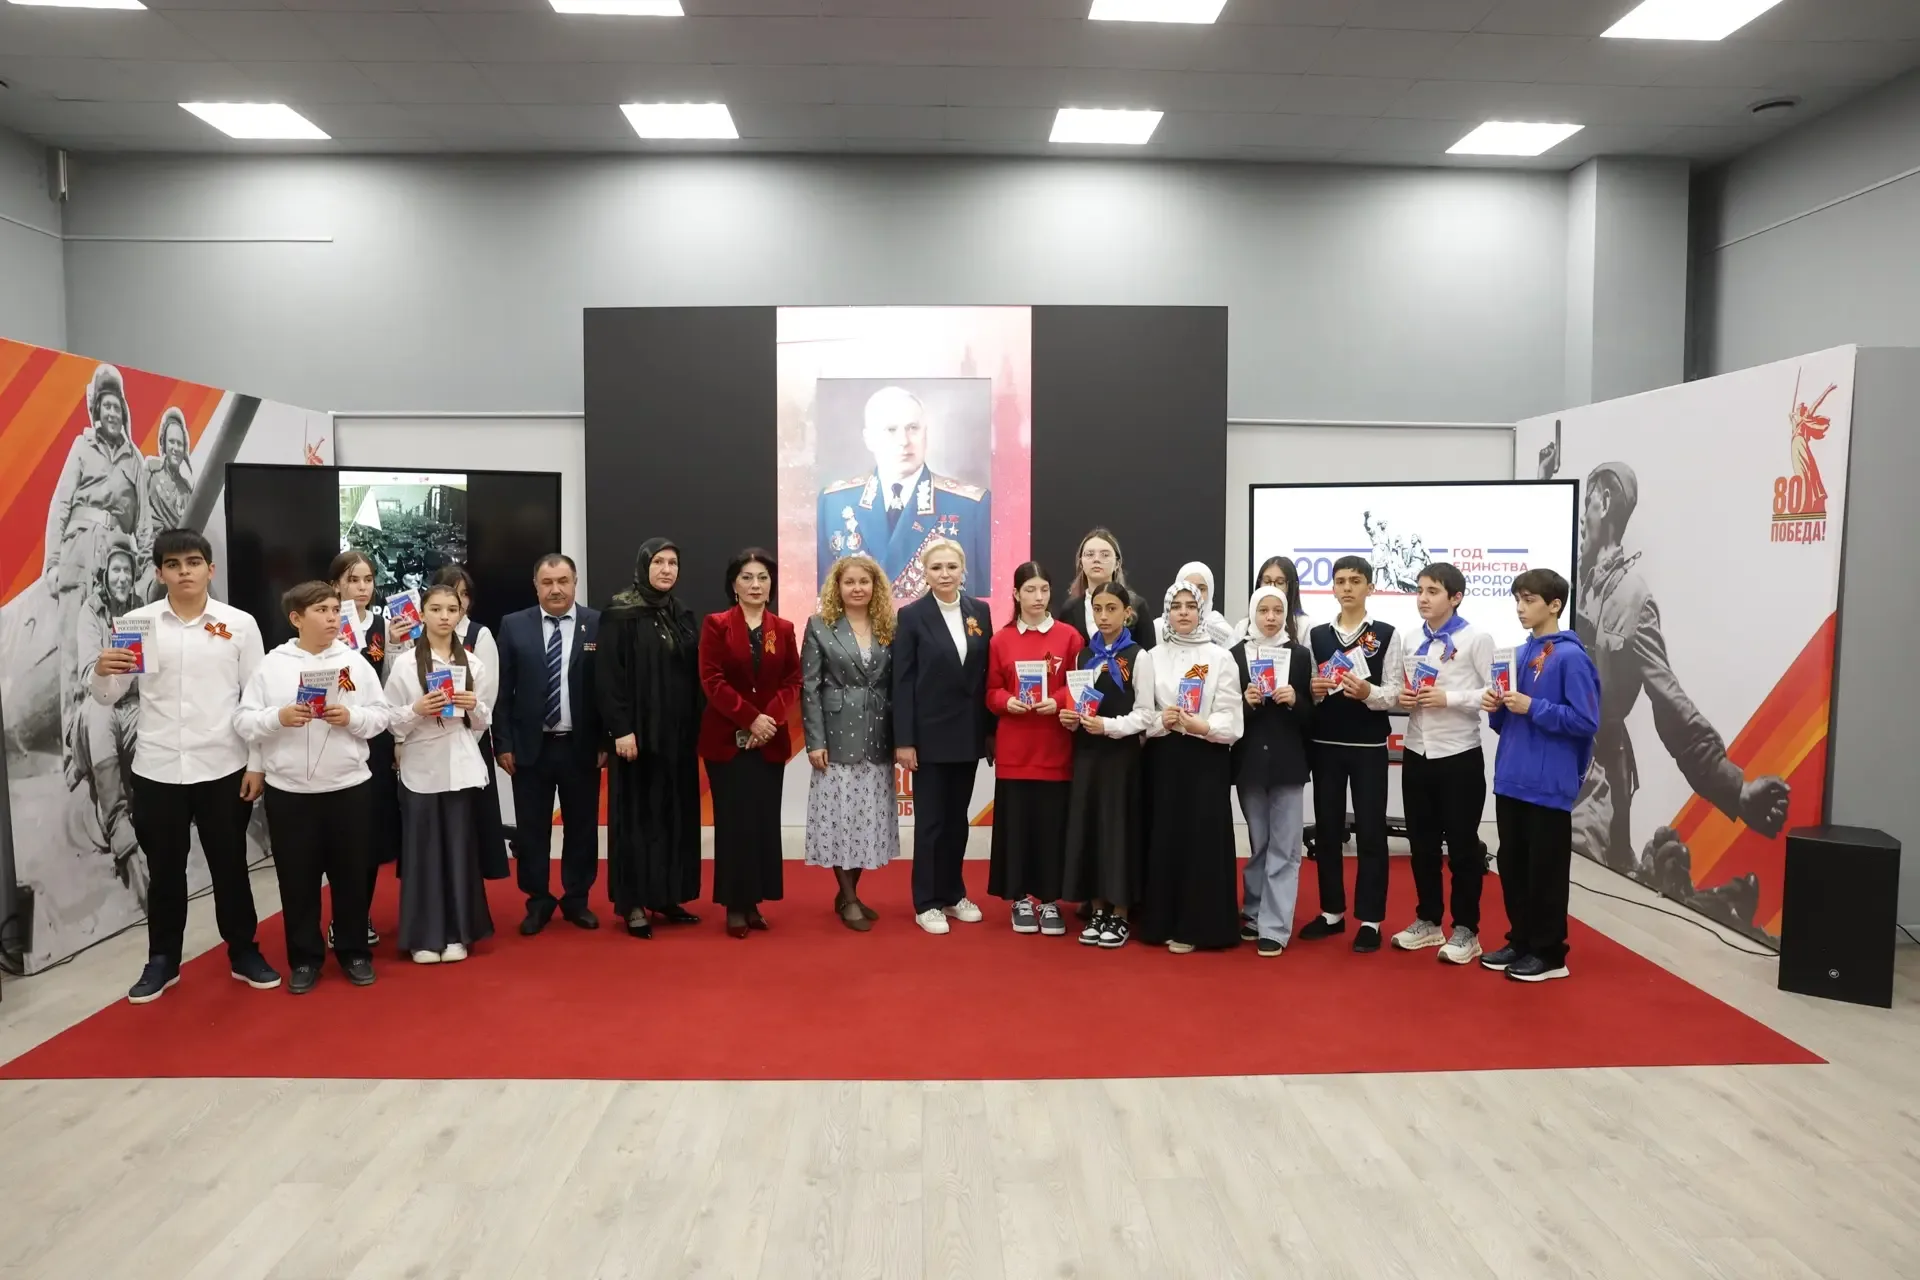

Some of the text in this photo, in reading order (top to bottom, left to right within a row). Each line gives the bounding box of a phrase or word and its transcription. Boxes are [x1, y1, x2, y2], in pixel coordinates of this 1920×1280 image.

[1773, 475, 1803, 514] 80
[1771, 521, 1826, 544] ПОБЕДА!
[1453, 548, 1483, 560] ГОД
[1294, 556, 1333, 587] 20
[1453, 562, 1529, 573] ЕДИНСТВА
[1464, 574, 1517, 586] АРОДО
[1464, 588, 1513, 597] ОССИИ
